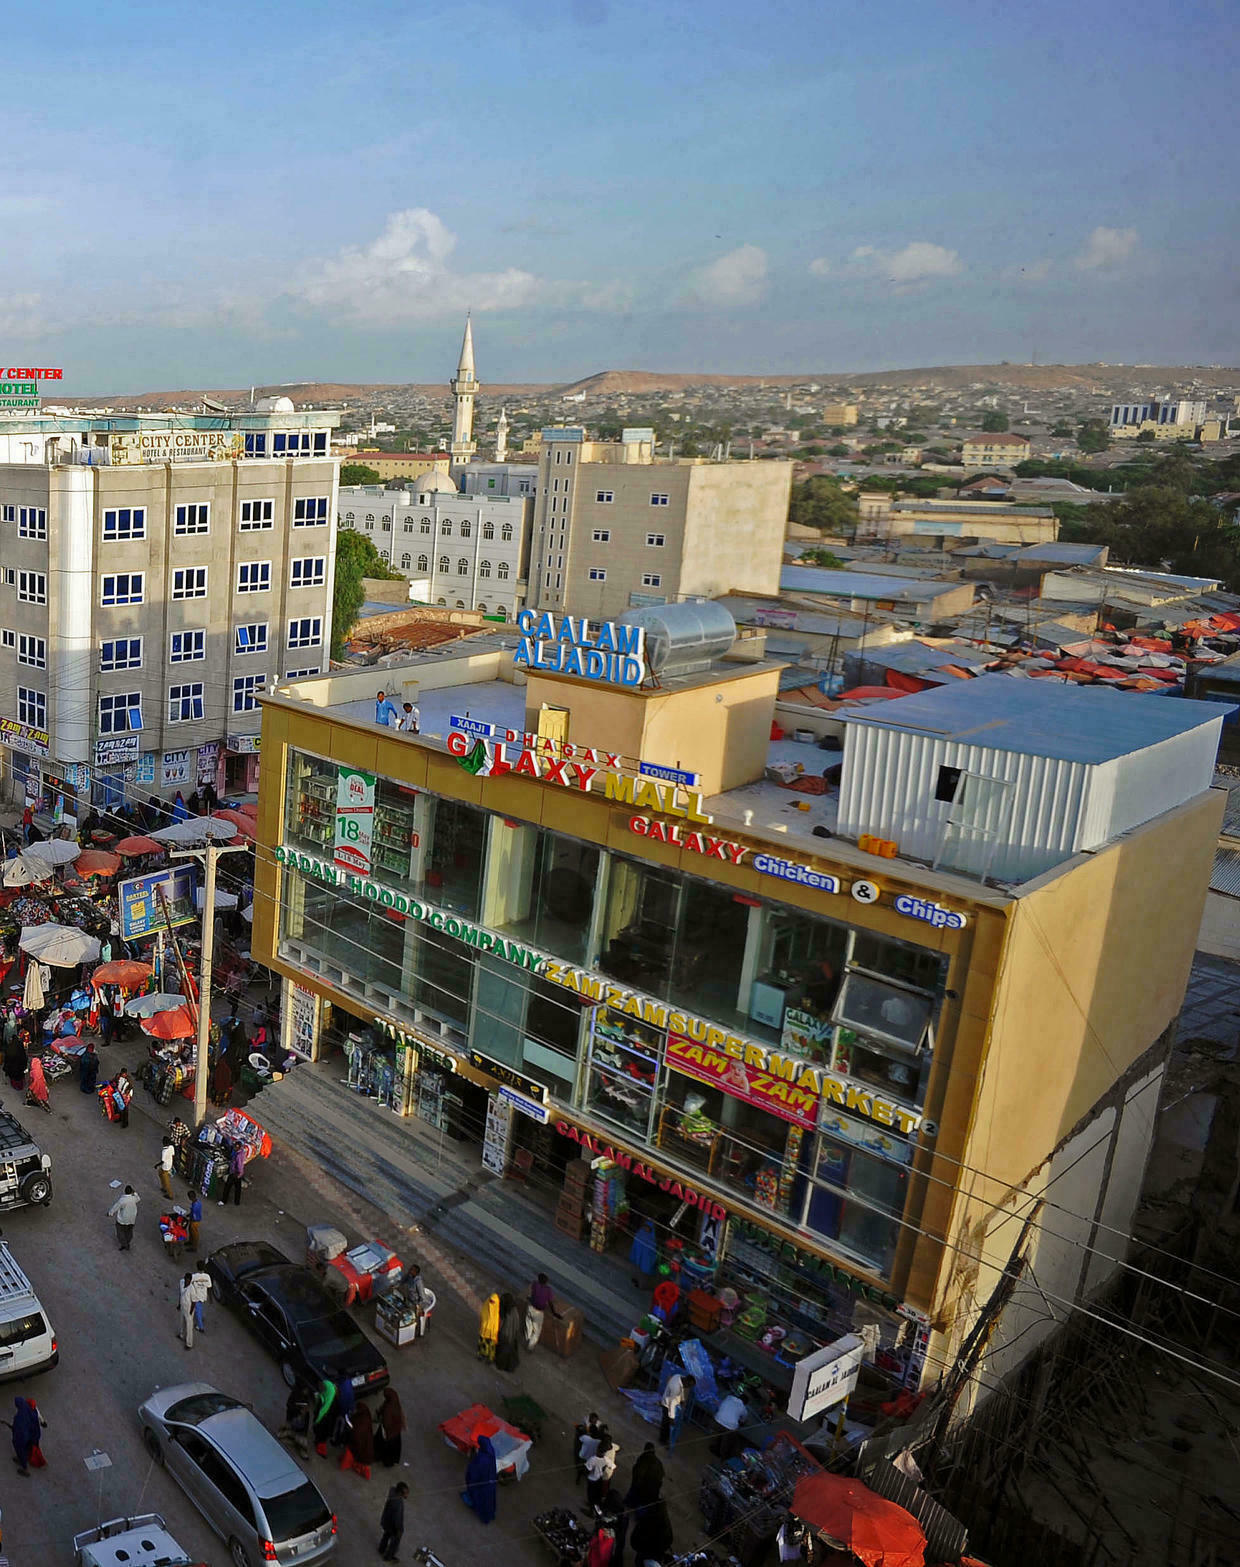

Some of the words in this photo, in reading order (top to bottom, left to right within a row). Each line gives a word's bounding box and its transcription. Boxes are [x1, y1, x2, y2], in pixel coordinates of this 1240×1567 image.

[7, 367, 63, 379] CENTER
[141, 434, 171, 448] CITY
[175, 433, 225, 447] CENTER
[142, 448, 161, 458] HOTEL
[162, 448, 167, 456] &
[169, 447, 207, 457] RESTAURANT
[519, 609, 645, 654] CAALAM
[456, 718, 486, 734] XAAJI
[164, 750, 188, 763] CITY
[198, 743, 218, 755] CITY
[447, 732, 601, 792] GALAXY
[505, 730, 622, 769] DHAGAX
[642, 764, 688, 784] TOWER
[604, 770, 714, 824] MALL
[337, 816, 360, 842] 18
[628, 815, 750, 865] GALAXY
[754, 854, 834, 891] Chicken
[857, 884, 871, 900] &
[896, 896, 962, 929] Chips
[429, 909, 544, 973] COMPANY
[545, 962, 605, 1002] ZAM
[607, 986, 667, 1028] ZAM
[667, 1040, 729, 1074] ZAM
[750, 1073, 816, 1111] ZAM
[924, 1123, 936, 1134] 2
[555, 1121, 632, 1170] CAALAM
[659, 1179, 727, 1221] JADIID
